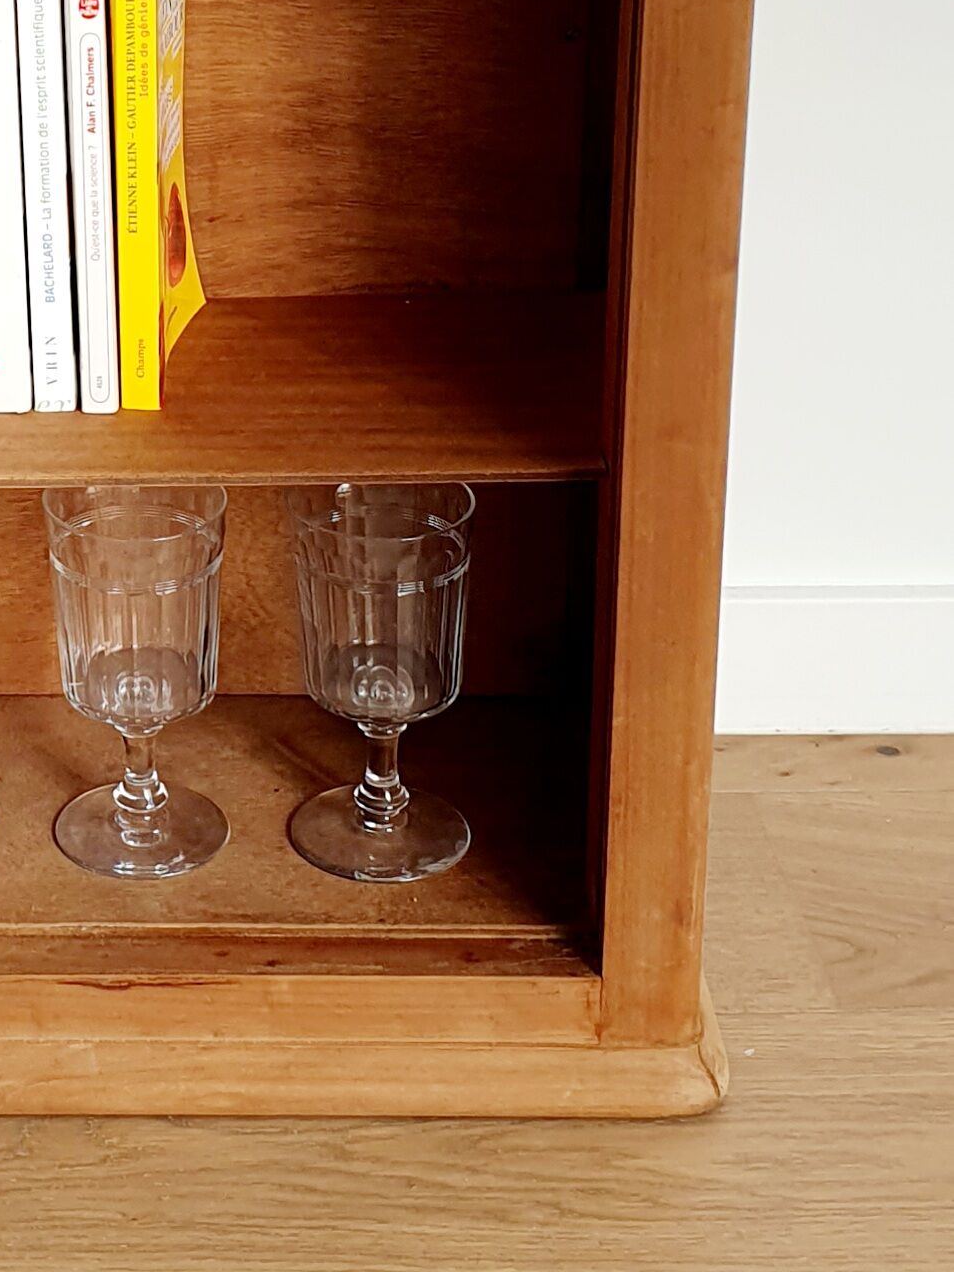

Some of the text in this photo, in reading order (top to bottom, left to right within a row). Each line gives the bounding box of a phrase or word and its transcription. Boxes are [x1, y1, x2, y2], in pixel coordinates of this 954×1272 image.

[139, 42, 149, 59] de
[35, 74, 48, 119] l'esprit
[86, 46, 97, 134] Alan F. Chalmers
[139, 63, 149, 97] Idées
[126, 76, 137, 130] GAUTIER
[38, 122, 49, 138] de
[38, 141, 52, 204] formation
[89, 153, 99, 188] science
[127, 142, 138, 180] KLEIN
[42, 207, 53, 220] La
[89, 190, 99, 199] la
[91, 201, 101, 218] que
[126, 181, 138, 234] ÉTIENNE
[42, 233, 55, 303] BACHELARD
[136, 338, 146, 379] Champs
